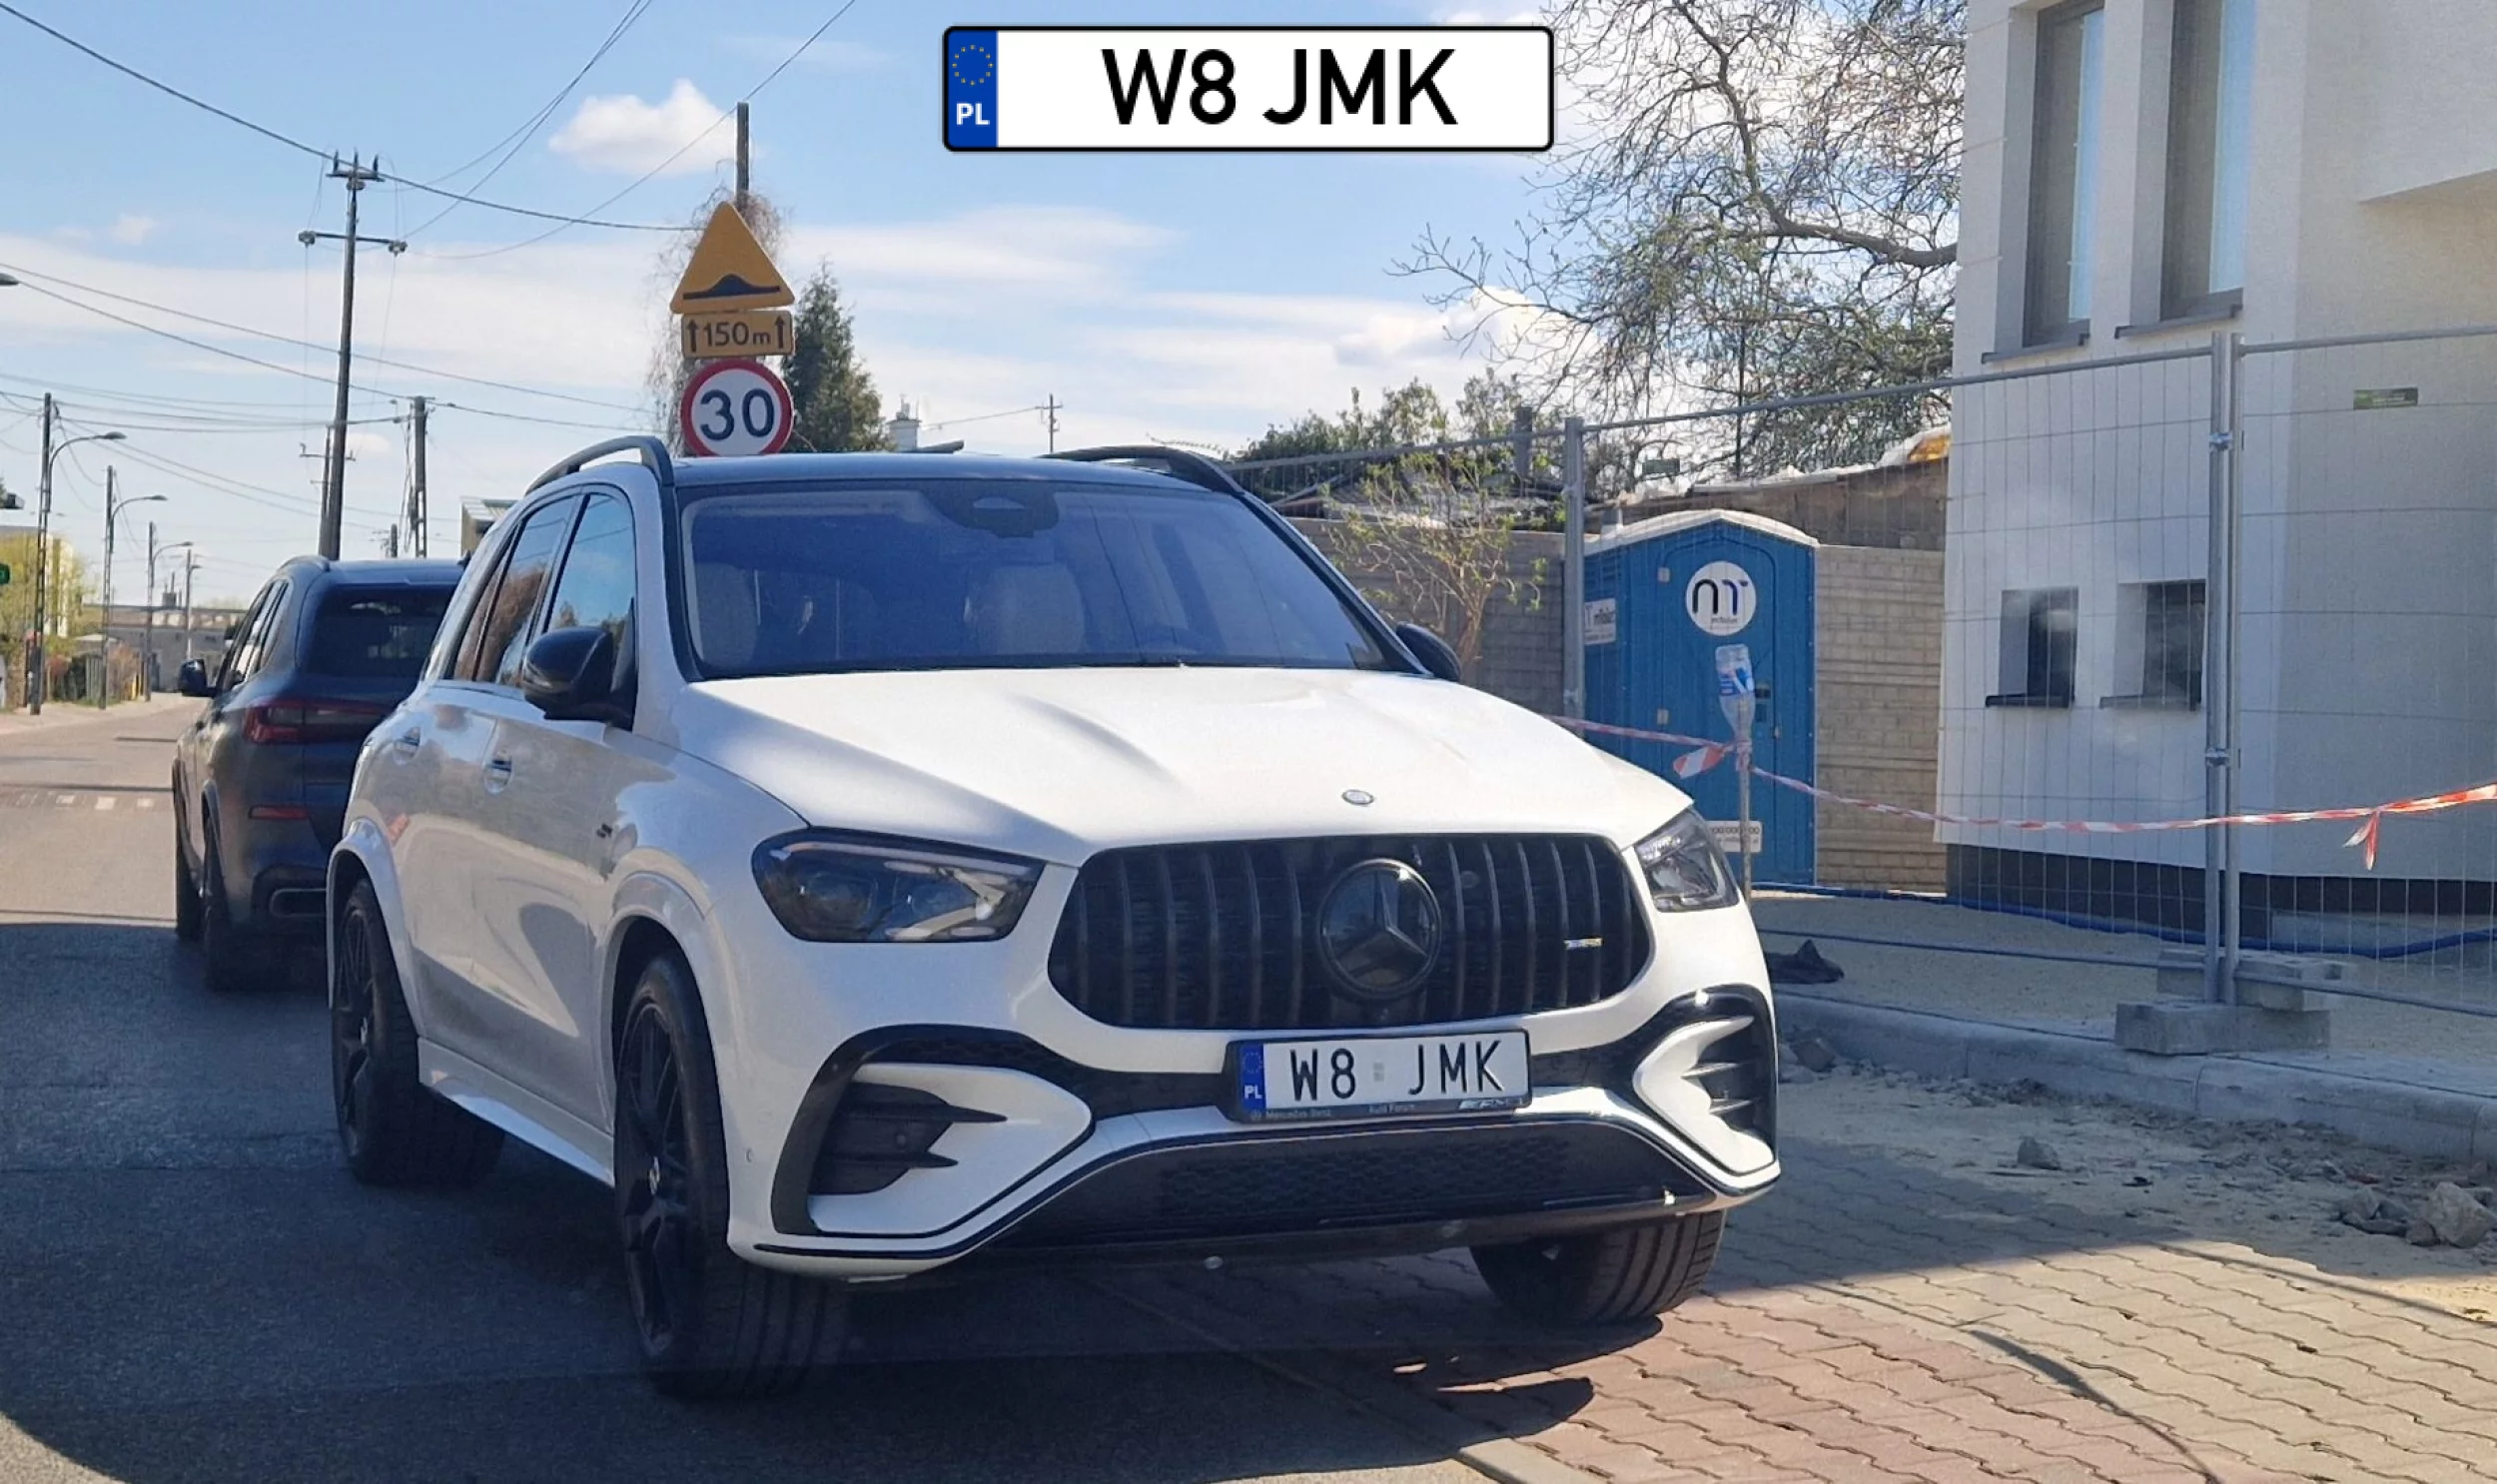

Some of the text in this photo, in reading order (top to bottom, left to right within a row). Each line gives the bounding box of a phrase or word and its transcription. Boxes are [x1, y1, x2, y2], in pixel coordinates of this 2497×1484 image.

[702, 321, 771, 349] 150 m
[699, 387, 775, 442] 30
[1288, 1039, 1504, 1102] W8 JMK
[1244, 1085, 1262, 1100] PL
